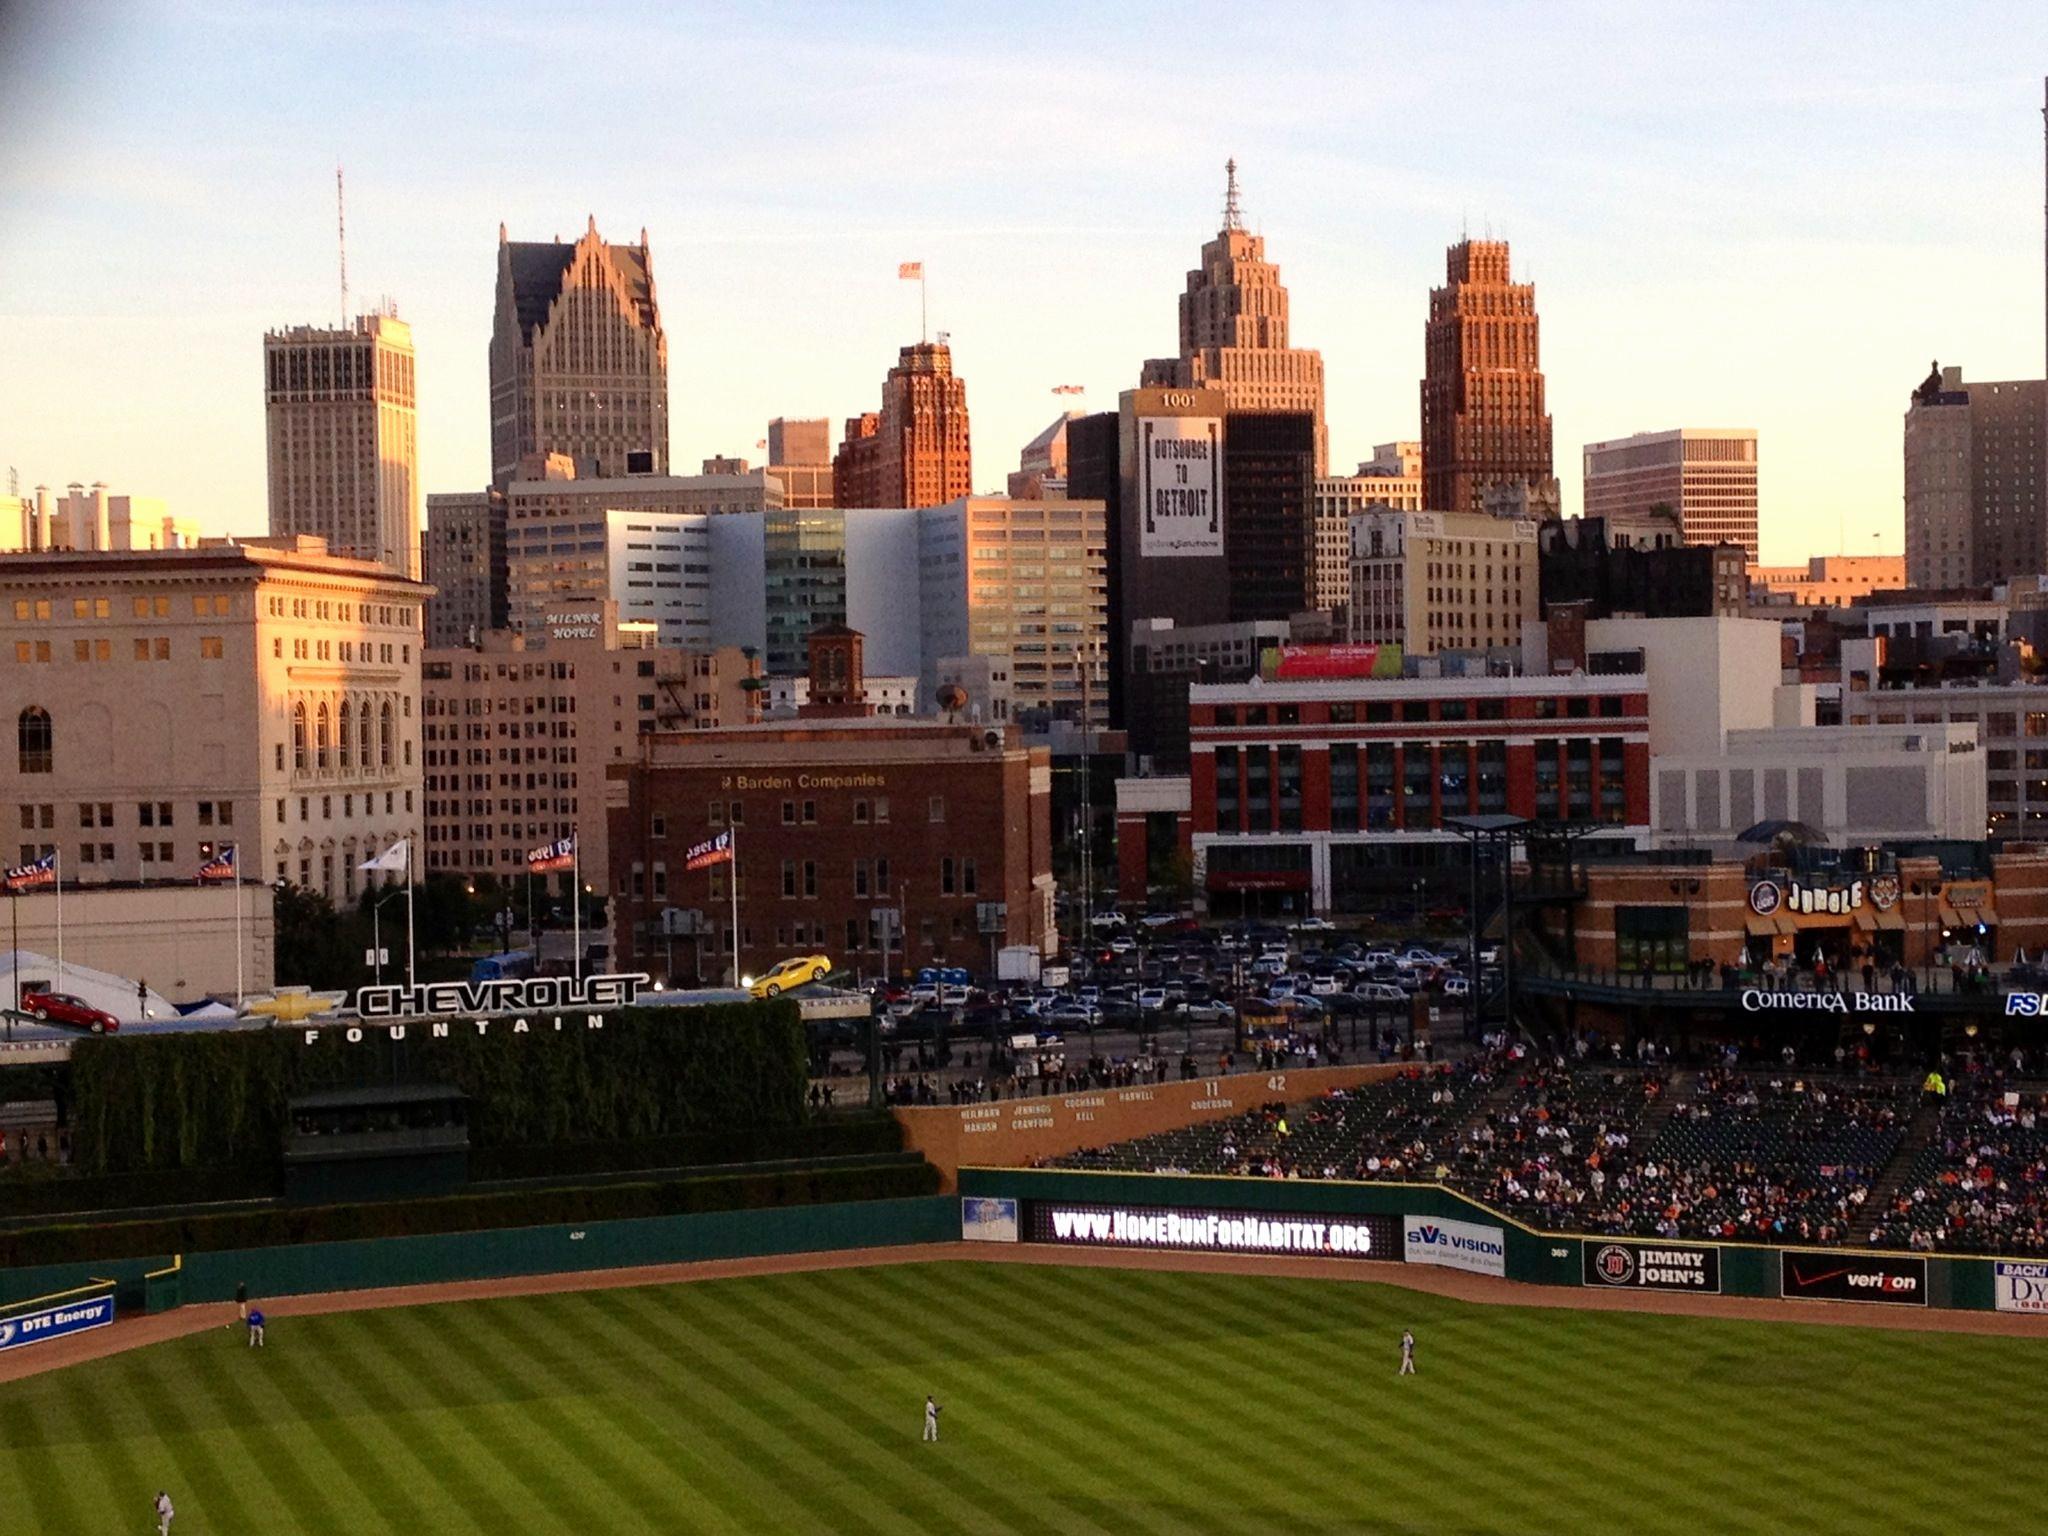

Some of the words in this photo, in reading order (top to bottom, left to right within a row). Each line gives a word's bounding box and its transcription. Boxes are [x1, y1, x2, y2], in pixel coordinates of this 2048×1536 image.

[1163, 393, 1196, 408] 1001
[1155, 439, 1208, 460] OUTSOURCE
[1176, 464, 1188, 484] TO
[1156, 488, 1208, 517] DETROIT
[546, 613, 602, 625] MILNER
[553, 628, 597, 639] HOTEL
[737, 775, 792, 789] Barden
[798, 773, 886, 789] Companies
[1788, 880, 1862, 914] JUNGLE
[357, 974, 650, 1019] CHEVROLET
[1854, 991, 1916, 1012] Bank
[304, 1015, 604, 1045] FOUNTAIN
[1204, 1081, 1219, 1097] 11
[1267, 1075, 1287, 1092] 42
[1119, 1090, 1155, 1103] HARWELL
[1190, 1100, 1234, 1111] ANDERSON
[1011, 1118, 1055, 1131] CRAWFORD
[1075, 1111, 1096, 1122] KELL
[1451, 1235, 1503, 1256] VISION
[1639, 1250, 1705, 1267] JIMMY
[1638, 1268, 1706, 1285] JOHN'S
[1847, 1272, 1917, 1292] verizon
[22, 1314, 52, 1333] DTE
[55, 1304, 107, 1325] Energy
